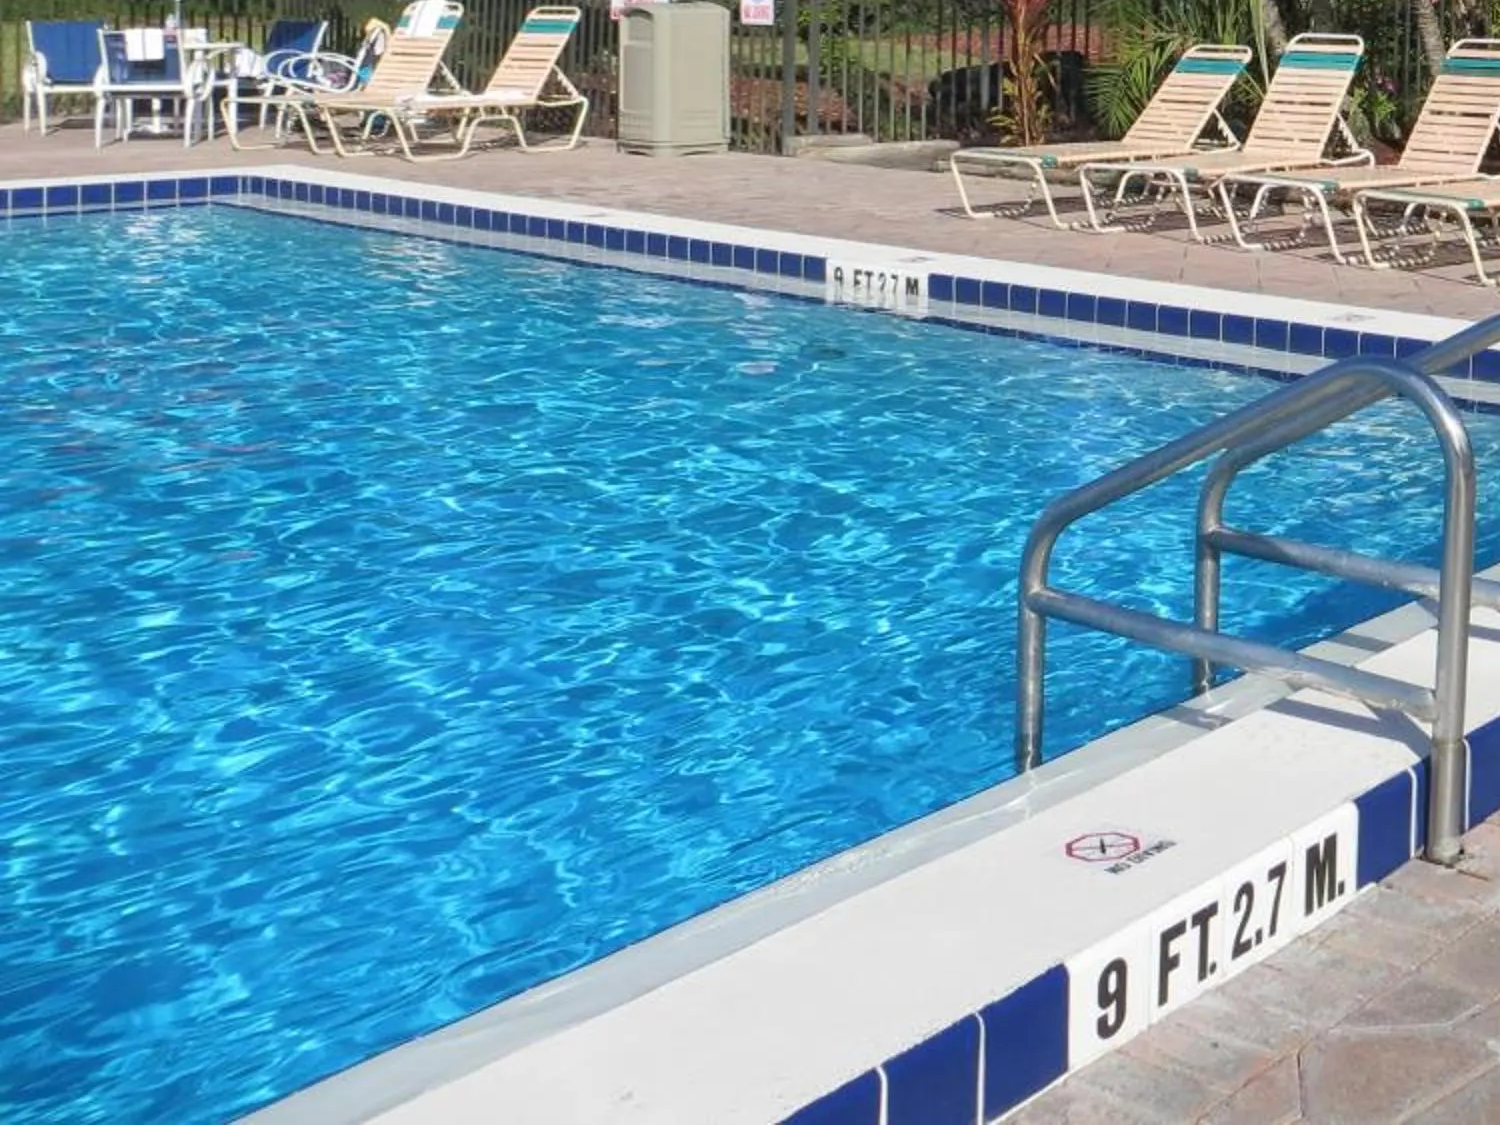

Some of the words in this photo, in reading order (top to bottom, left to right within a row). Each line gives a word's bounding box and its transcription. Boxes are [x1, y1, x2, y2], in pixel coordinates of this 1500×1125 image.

[1096, 957, 1128, 1040] 9
[1158, 900, 1219, 1007] FT.
[1231, 860, 1288, 961] 2.7
[1304, 832, 1346, 917] M.
